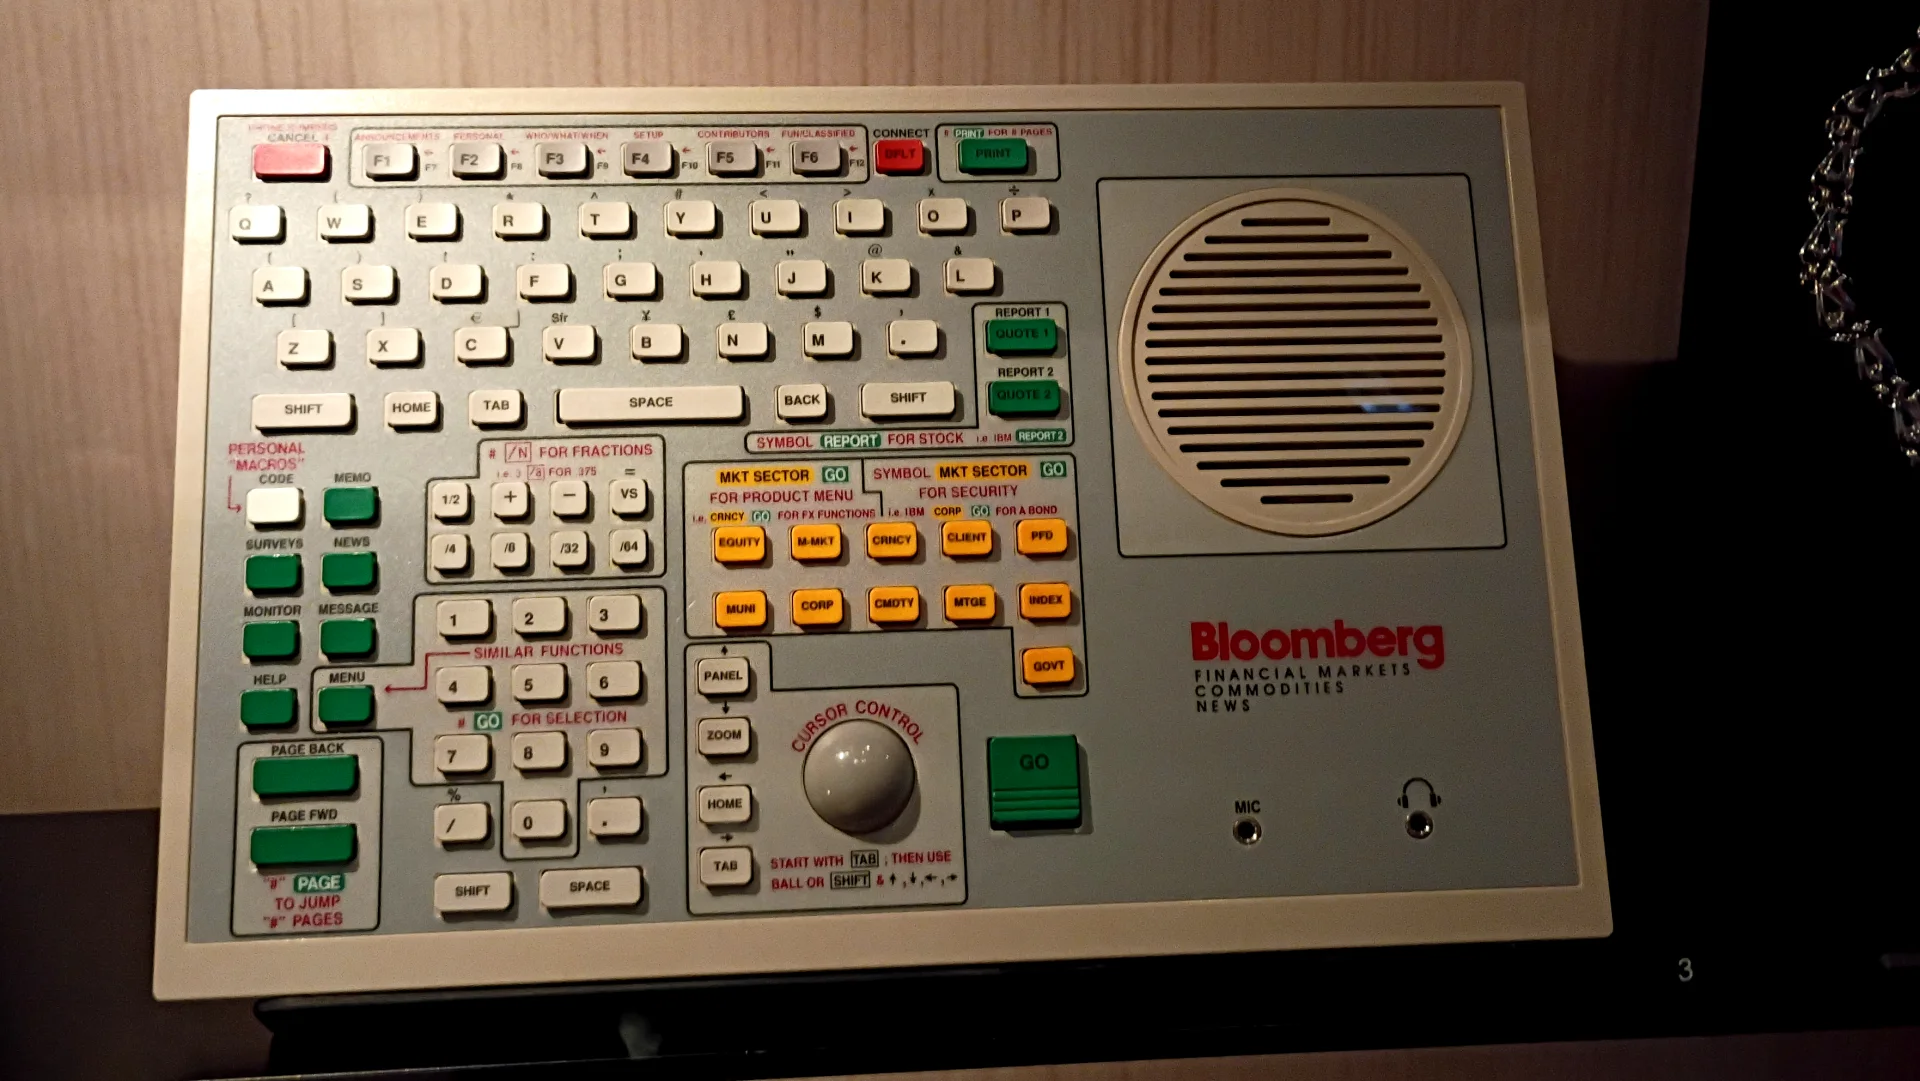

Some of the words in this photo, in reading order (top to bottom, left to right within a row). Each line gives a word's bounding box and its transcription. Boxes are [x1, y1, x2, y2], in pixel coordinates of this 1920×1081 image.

[268, 133, 319, 143] CANCEL
[453, 132, 504, 140] PERSONAL
[634, 131, 663, 139] SETUP
[697, 130, 770, 139] CONTRIBUTORS
[781, 129, 855, 138] FUN/CLASSIFIED
[873, 128, 930, 138] CONNECT
[988, 129, 1008, 137] FOR
[1019, 128, 1053, 136] PAGES
[546, 153, 564, 165] F3
[632, 153, 650, 165] F4
[717, 152, 734, 164] F5
[801, 152, 819, 163] F6
[975, 149, 1011, 158] PRINT
[374, 155, 390, 167] F1
[460, 154, 479, 166] F2
[417, 215, 427, 228] E
[503, 215, 514, 227] R
[590, 213, 600, 226] T
[676, 212, 686, 224] Y
[761, 212, 771, 224] U
[927, 210, 939, 222] O
[1011, 210, 1022, 222] P
[239, 218, 252, 230] Q
[326, 217, 342, 229] W
[530, 275, 540, 287] F
[615, 274, 627, 286] G
[701, 274, 711, 285] H
[787, 272, 796, 284] J
[871, 272, 883, 283] K
[956, 270, 965, 282] L
[263, 280, 274, 292] A
[352, 279, 363, 291] S
[442, 277, 453, 289] D
[996, 308, 1040, 317] REPORT
[812, 334, 824, 346] M
[996, 329, 1038, 339] QUOTE
[378, 340, 389, 352] X
[466, 339, 477, 351] C
[554, 338, 564, 350] V
[641, 337, 652, 349] B
[728, 335, 738, 346] N
[288, 343, 298, 355] Z
[998, 367, 1044, 377] REPORT
[784, 394, 820, 405] BACK
[890, 392, 927, 403] SHIFT
[997, 390, 1040, 400] QUOTE
[392, 402, 431, 413] HOME
[483, 400, 509, 411] TAB
[629, 397, 673, 407] SPACE
[285, 403, 323, 414] SHIFT
[757, 437, 813, 448] SYMBOL
[824, 435, 878, 447] REPORT
[888, 434, 916, 445] FOR
[919, 432, 964, 444] STOCK
[1019, 431, 1055, 440] REPORT
[229, 443, 305, 455] PERSONAL
[539, 446, 568, 458] FOR
[572, 444, 653, 458] FRACTIONS
[230, 458, 304, 471] "MACROS"
[335, 472, 371, 483] MEMO
[549, 467, 572, 476] FOR
[720, 470, 749, 483] MKT
[754, 469, 809, 482] SECTOR
[825, 468, 846, 481] GO
[874, 467, 930, 480] SYMBOL
[940, 466, 968, 478] MKT
[972, 465, 1027, 477] SECTOR
[1043, 463, 1064, 475] GO
[259, 474, 293, 484] CODE
[621, 489, 638, 498] VS
[710, 493, 737, 504] FOR
[743, 491, 809, 503] PRODUCT
[814, 490, 853, 501] MENU
[919, 487, 946, 498] FOR
[952, 485, 1018, 497] SECURITY
[443, 495, 460, 505] 1/2
[710, 512, 744, 521] CRNCY
[753, 511, 770, 522] GO
[778, 511, 799, 520] FOR
[802, 511, 814, 519] FX
[818, 509, 875, 519] FUNCTIONS
[906, 507, 924, 516] IBM
[934, 507, 961, 516] CORP
[972, 506, 989, 516] GO
[996, 507, 1016, 516] FOR
[1029, 506, 1057, 515] BOND
[797, 536, 834, 547] M-MKT
[872, 535, 912, 546] CRNCY
[947, 532, 986, 544] CLIENT
[1031, 530, 1053, 541] PFD
[246, 539, 303, 550] SURVEYS
[334, 537, 370, 548] NEWS
[560, 543, 579, 553] /32
[620, 541, 638, 552] /64
[719, 537, 760, 547] EQUITY
[801, 600, 834, 611] CORP
[874, 598, 914, 609] CMDTY
[954, 597, 986, 608] MTGE
[1029, 594, 1063, 605] INDEX
[244, 605, 301, 617] MONITOR
[319, 603, 379, 614] MESSAGE
[726, 604, 755, 614] MUNI
[525, 613, 534, 625] 2
[600, 609, 609, 621] 3
[1190, 619, 1445, 670] Bloomberg
[474, 646, 533, 659] SIMILAR
[541, 643, 624, 657] FUNCTIONS
[1033, 661, 1065, 672] GOVT
[1195, 667, 1306, 682] FINANCIAL
[1319, 663, 1410, 678] MARKETS
[254, 675, 287, 685] HELP
[329, 672, 365, 683] MENU
[704, 670, 743, 681] PANEL
[449, 682, 457, 693] 4
[524, 679, 533, 691] 5
[600, 676, 609, 688] 6
[1195, 681, 1344, 697] COMMODITIES
[1197, 700, 1250, 713] NEWS
[477, 715, 499, 728] GO
[512, 713, 541, 725] FOR
[547, 711, 627, 724] SELECTION
[791, 703, 848, 753] CURSOR
[855, 700, 925, 745] CONTROL
[707, 729, 742, 741] ZOOM
[272, 745, 305, 756] PAGE
[310, 743, 344, 754] BACK
[524, 747, 533, 759] 8
[600, 744, 609, 756] 9
[448, 751, 457, 763] 7
[1020, 754, 1049, 770] GO
[707, 798, 742, 809] HOME
[1235, 800, 1261, 814] MIC
[271, 811, 305, 822] PAGE
[310, 809, 338, 820] FWD
[771, 855, 809, 869] START
[813, 854, 843, 867] WITH
[853, 854, 878, 865] TAB
[891, 852, 923, 864] THEN
[927, 850, 951, 863] USE
[714, 861, 738, 871] TAB
[298, 877, 341, 890] PAGE
[570, 881, 610, 892] SPACE
[771, 877, 803, 890] BALL
[806, 876, 824, 888] OR
[833, 873, 869, 886] SHIFT
[455, 885, 490, 897] SHIFT
[276, 898, 295, 910] TO
[300, 895, 341, 909] JUMP
[292, 913, 343, 927] PAGES
[1679, 957, 1693, 982] 3
